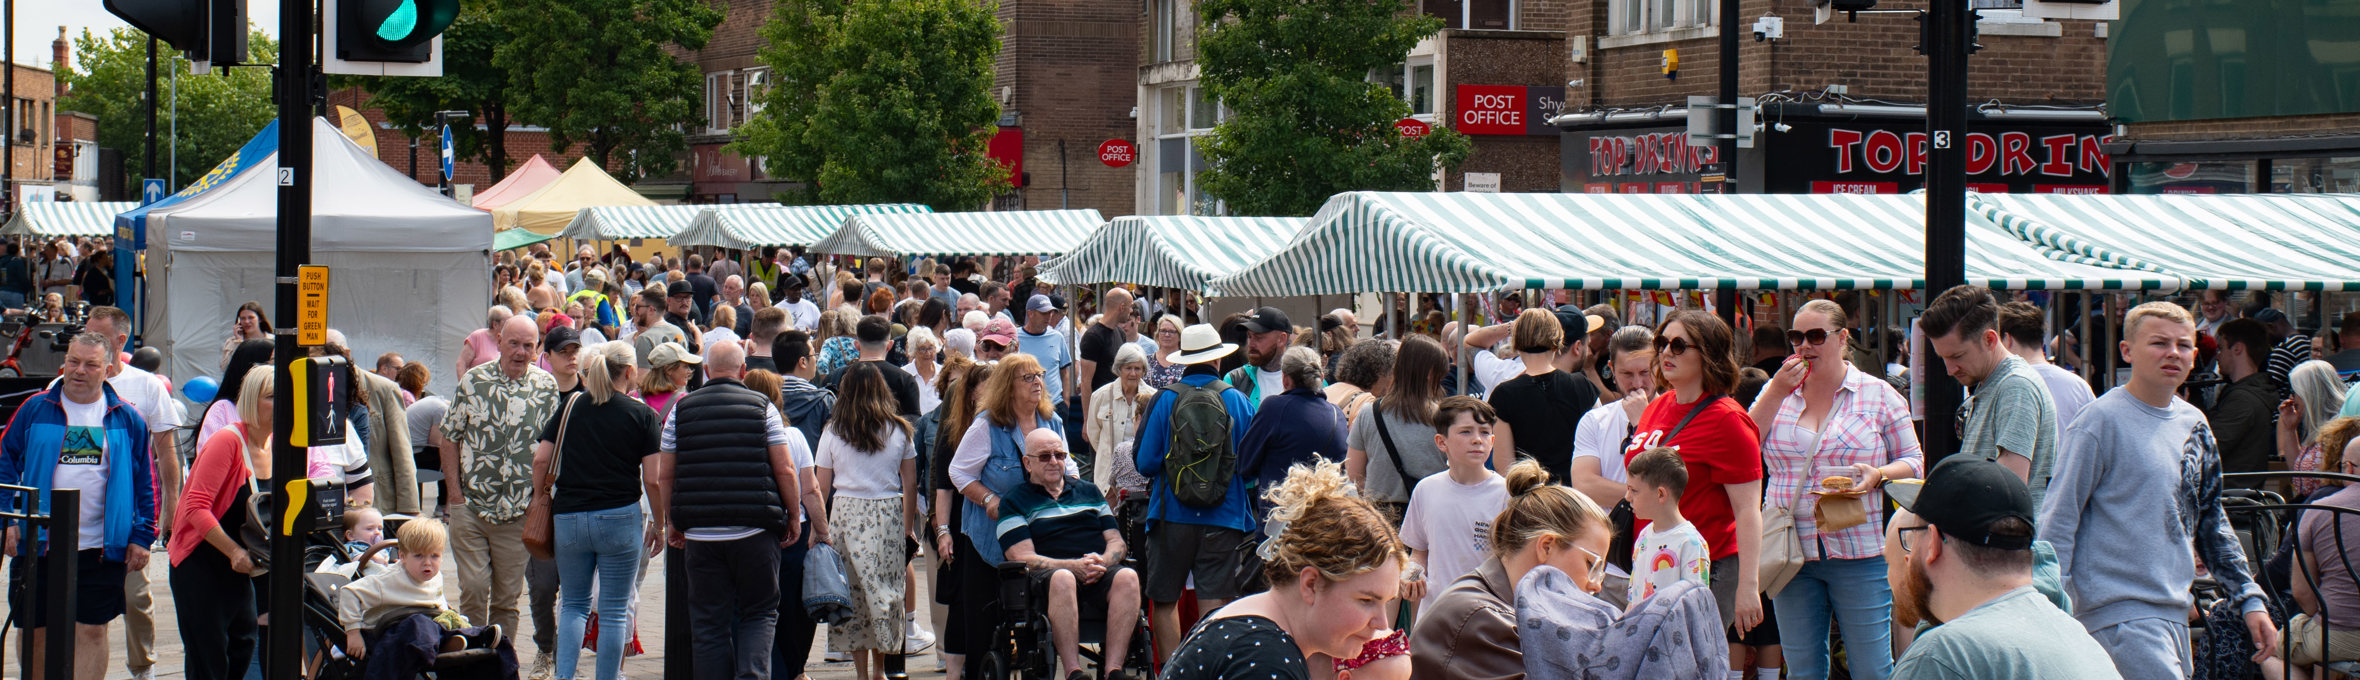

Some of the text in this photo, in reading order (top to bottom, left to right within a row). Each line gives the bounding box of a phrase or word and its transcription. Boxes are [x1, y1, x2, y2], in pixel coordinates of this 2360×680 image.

[1474, 94, 1515, 109] POST
[1464, 110, 1520, 125] OFFICE
[1936, 131, 1949, 148] 3
[1107, 145, 1128, 153] POST
[1829, 128, 1927, 175] TOP
[1101, 153, 1131, 161] OFFICE
[1589, 136, 1627, 177] TOP
[280, 169, 290, 184] 2
[1833, 184, 1877, 194] ICE CREAM
[306, 272, 321, 280] PUSH
[302, 282, 324, 290] BUTTON
[306, 300, 320, 308] WAIT
[307, 310, 318, 318] FOR
[303, 322, 321, 330] GREEN
[306, 332, 318, 340] MAN
[61, 455, 98, 464] Columbia
